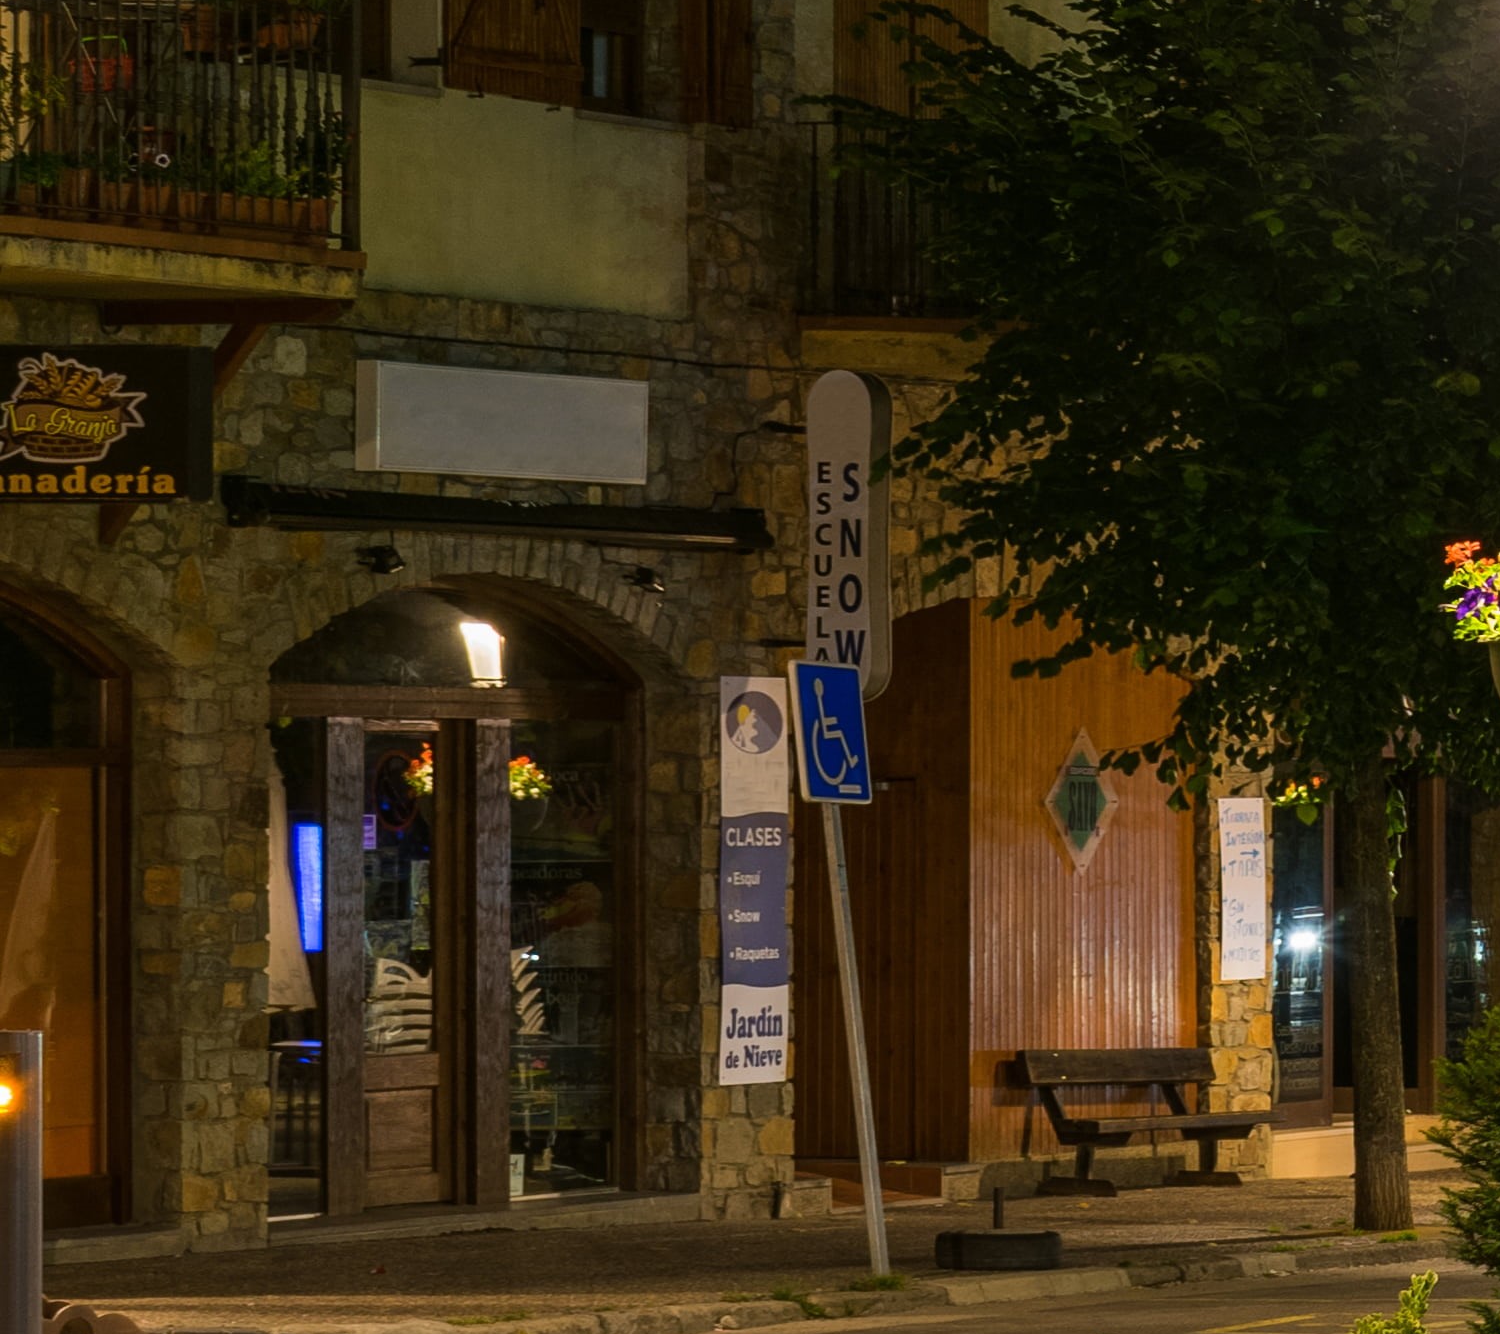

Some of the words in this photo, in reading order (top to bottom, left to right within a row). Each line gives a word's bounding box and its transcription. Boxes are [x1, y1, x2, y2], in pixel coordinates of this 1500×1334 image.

[9, 404, 37, 433] La
[45, 407, 118, 444] Granja
[834, 462, 866, 666] SNOW
[725, 827, 782, 847] CLASES
[732, 870, 762, 887] Esquí
[733, 909, 761, 923] Snow
[735, 946, 780, 963] Raquetas
[726, 1004, 783, 1040] Jardín
[725, 1050, 740, 1070] de
[743, 1044, 783, 1069] Nieve
